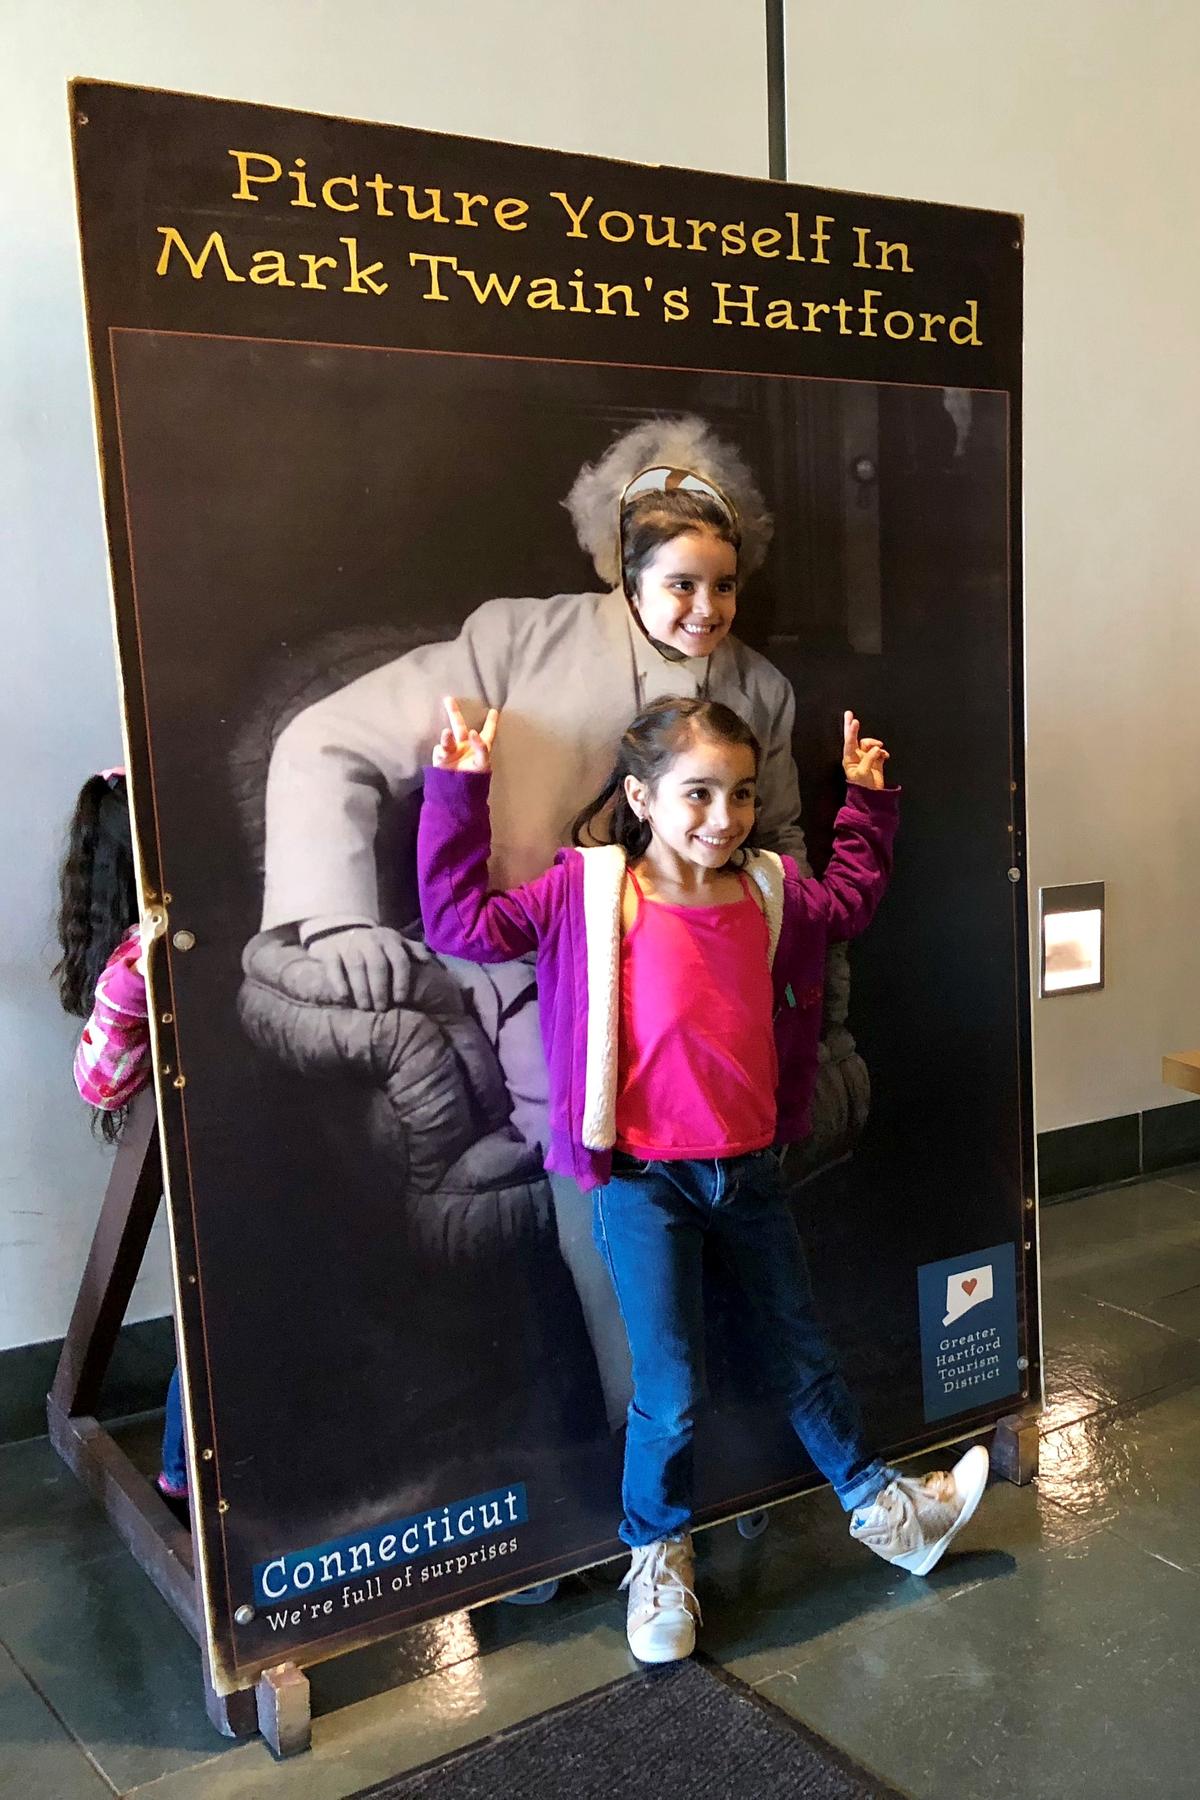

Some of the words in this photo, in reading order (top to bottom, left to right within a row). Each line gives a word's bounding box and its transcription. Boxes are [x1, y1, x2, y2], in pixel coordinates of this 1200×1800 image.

[229, 149, 529, 232] Picture
[550, 191, 836, 265] Yourself
[852, 226, 914, 273] In
[156, 226, 389, 296] Mark
[409, 252, 690, 323] Twain's
[711, 281, 983, 346] Hartford
[936, 1337, 1001, 1367] Hartford
[938, 1354, 1000, 1380] Tourism
[939, 1327, 998, 1352] Greater
[943, 1368, 1000, 1394] District
[261, 1491, 518, 1599] Connecticut
[266, 1600, 333, 1632] We're
[341, 1577, 383, 1611] full
[391, 1566, 412, 1592] of
[420, 1537, 518, 1582] surprises
